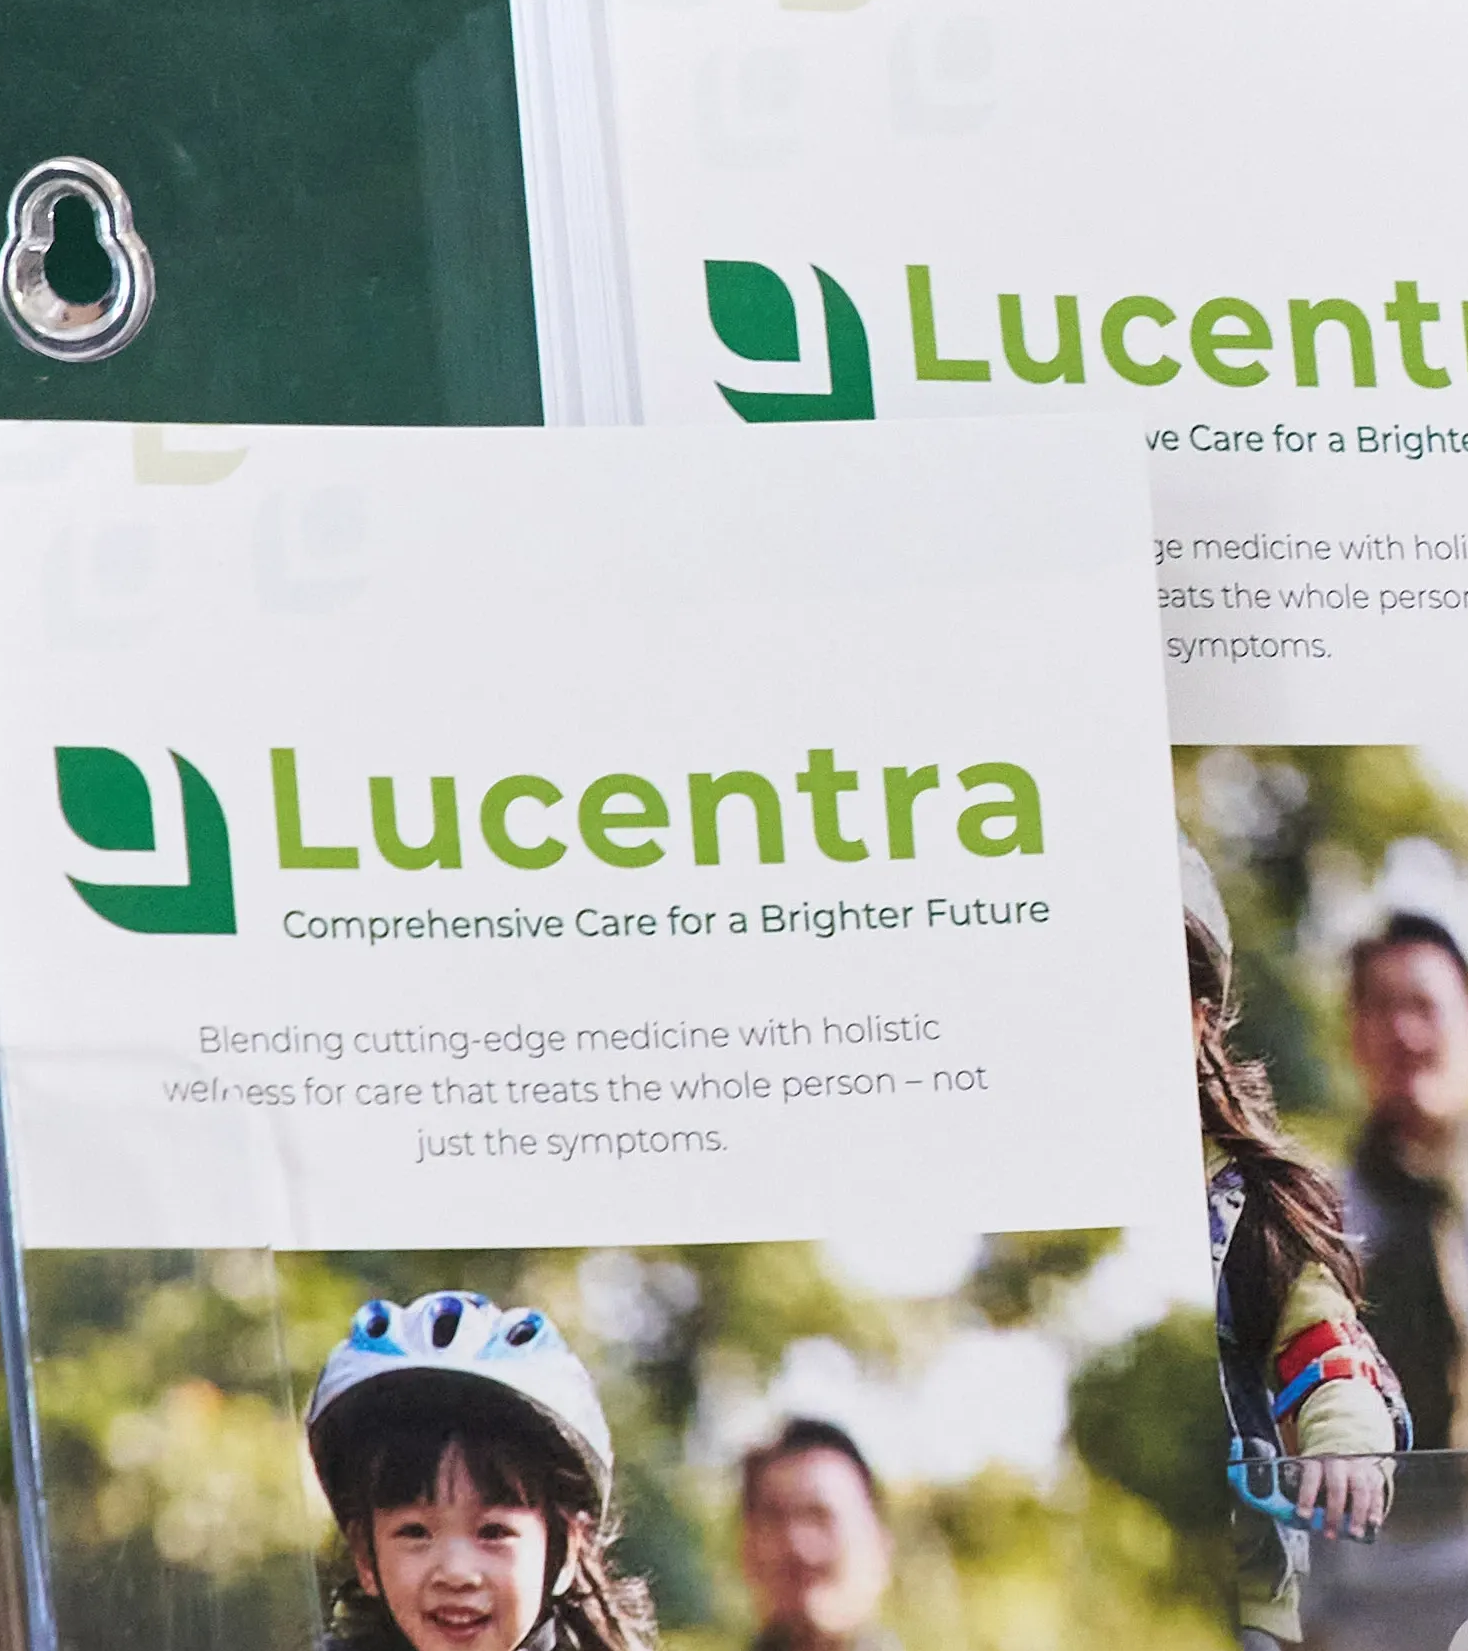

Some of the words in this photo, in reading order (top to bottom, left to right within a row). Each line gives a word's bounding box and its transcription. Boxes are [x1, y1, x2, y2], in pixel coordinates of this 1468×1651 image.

[1190, 424, 1264, 452] Care
[1272, 424, 1317, 452] for
[1328, 432, 1345, 453] a
[1193, 534, 1331, 561] medicine
[1339, 534, 1404, 560] with
[1158, 586, 1214, 609] eats
[1220, 582, 1271, 609] the
[1278, 583, 1369, 609] whole
[1167, 635, 1331, 664] symptoms.
[270, 748, 1044, 871] Lucentra
[284, 908, 564, 946] Comprehensive
[576, 909, 657, 937] Care
[667, 905, 716, 936] for
[729, 912, 747, 933] a
[761, 901, 913, 938] Brighter
[927, 899, 1050, 927] Future
[200, 1025, 344, 1060] Blending
[354, 1024, 566, 1059] cutting-edge
[577, 1020, 729, 1050] medicine
[739, 1018, 811, 1046] with
[823, 1014, 940, 1044] holistic
[304, 1077, 346, 1105] for
[356, 1084, 422, 1105] care
[431, 1077, 498, 1104] that
[506, 1079, 599, 1104] treats
[607, 1074, 662, 1102] the
[670, 1070, 771, 1100] whole
[783, 1073, 895, 1104] person
[934, 1067, 988, 1091] not
[416, 1129, 475, 1164] just
[484, 1128, 537, 1156] the
[547, 1129, 727, 1162] symptoms.
